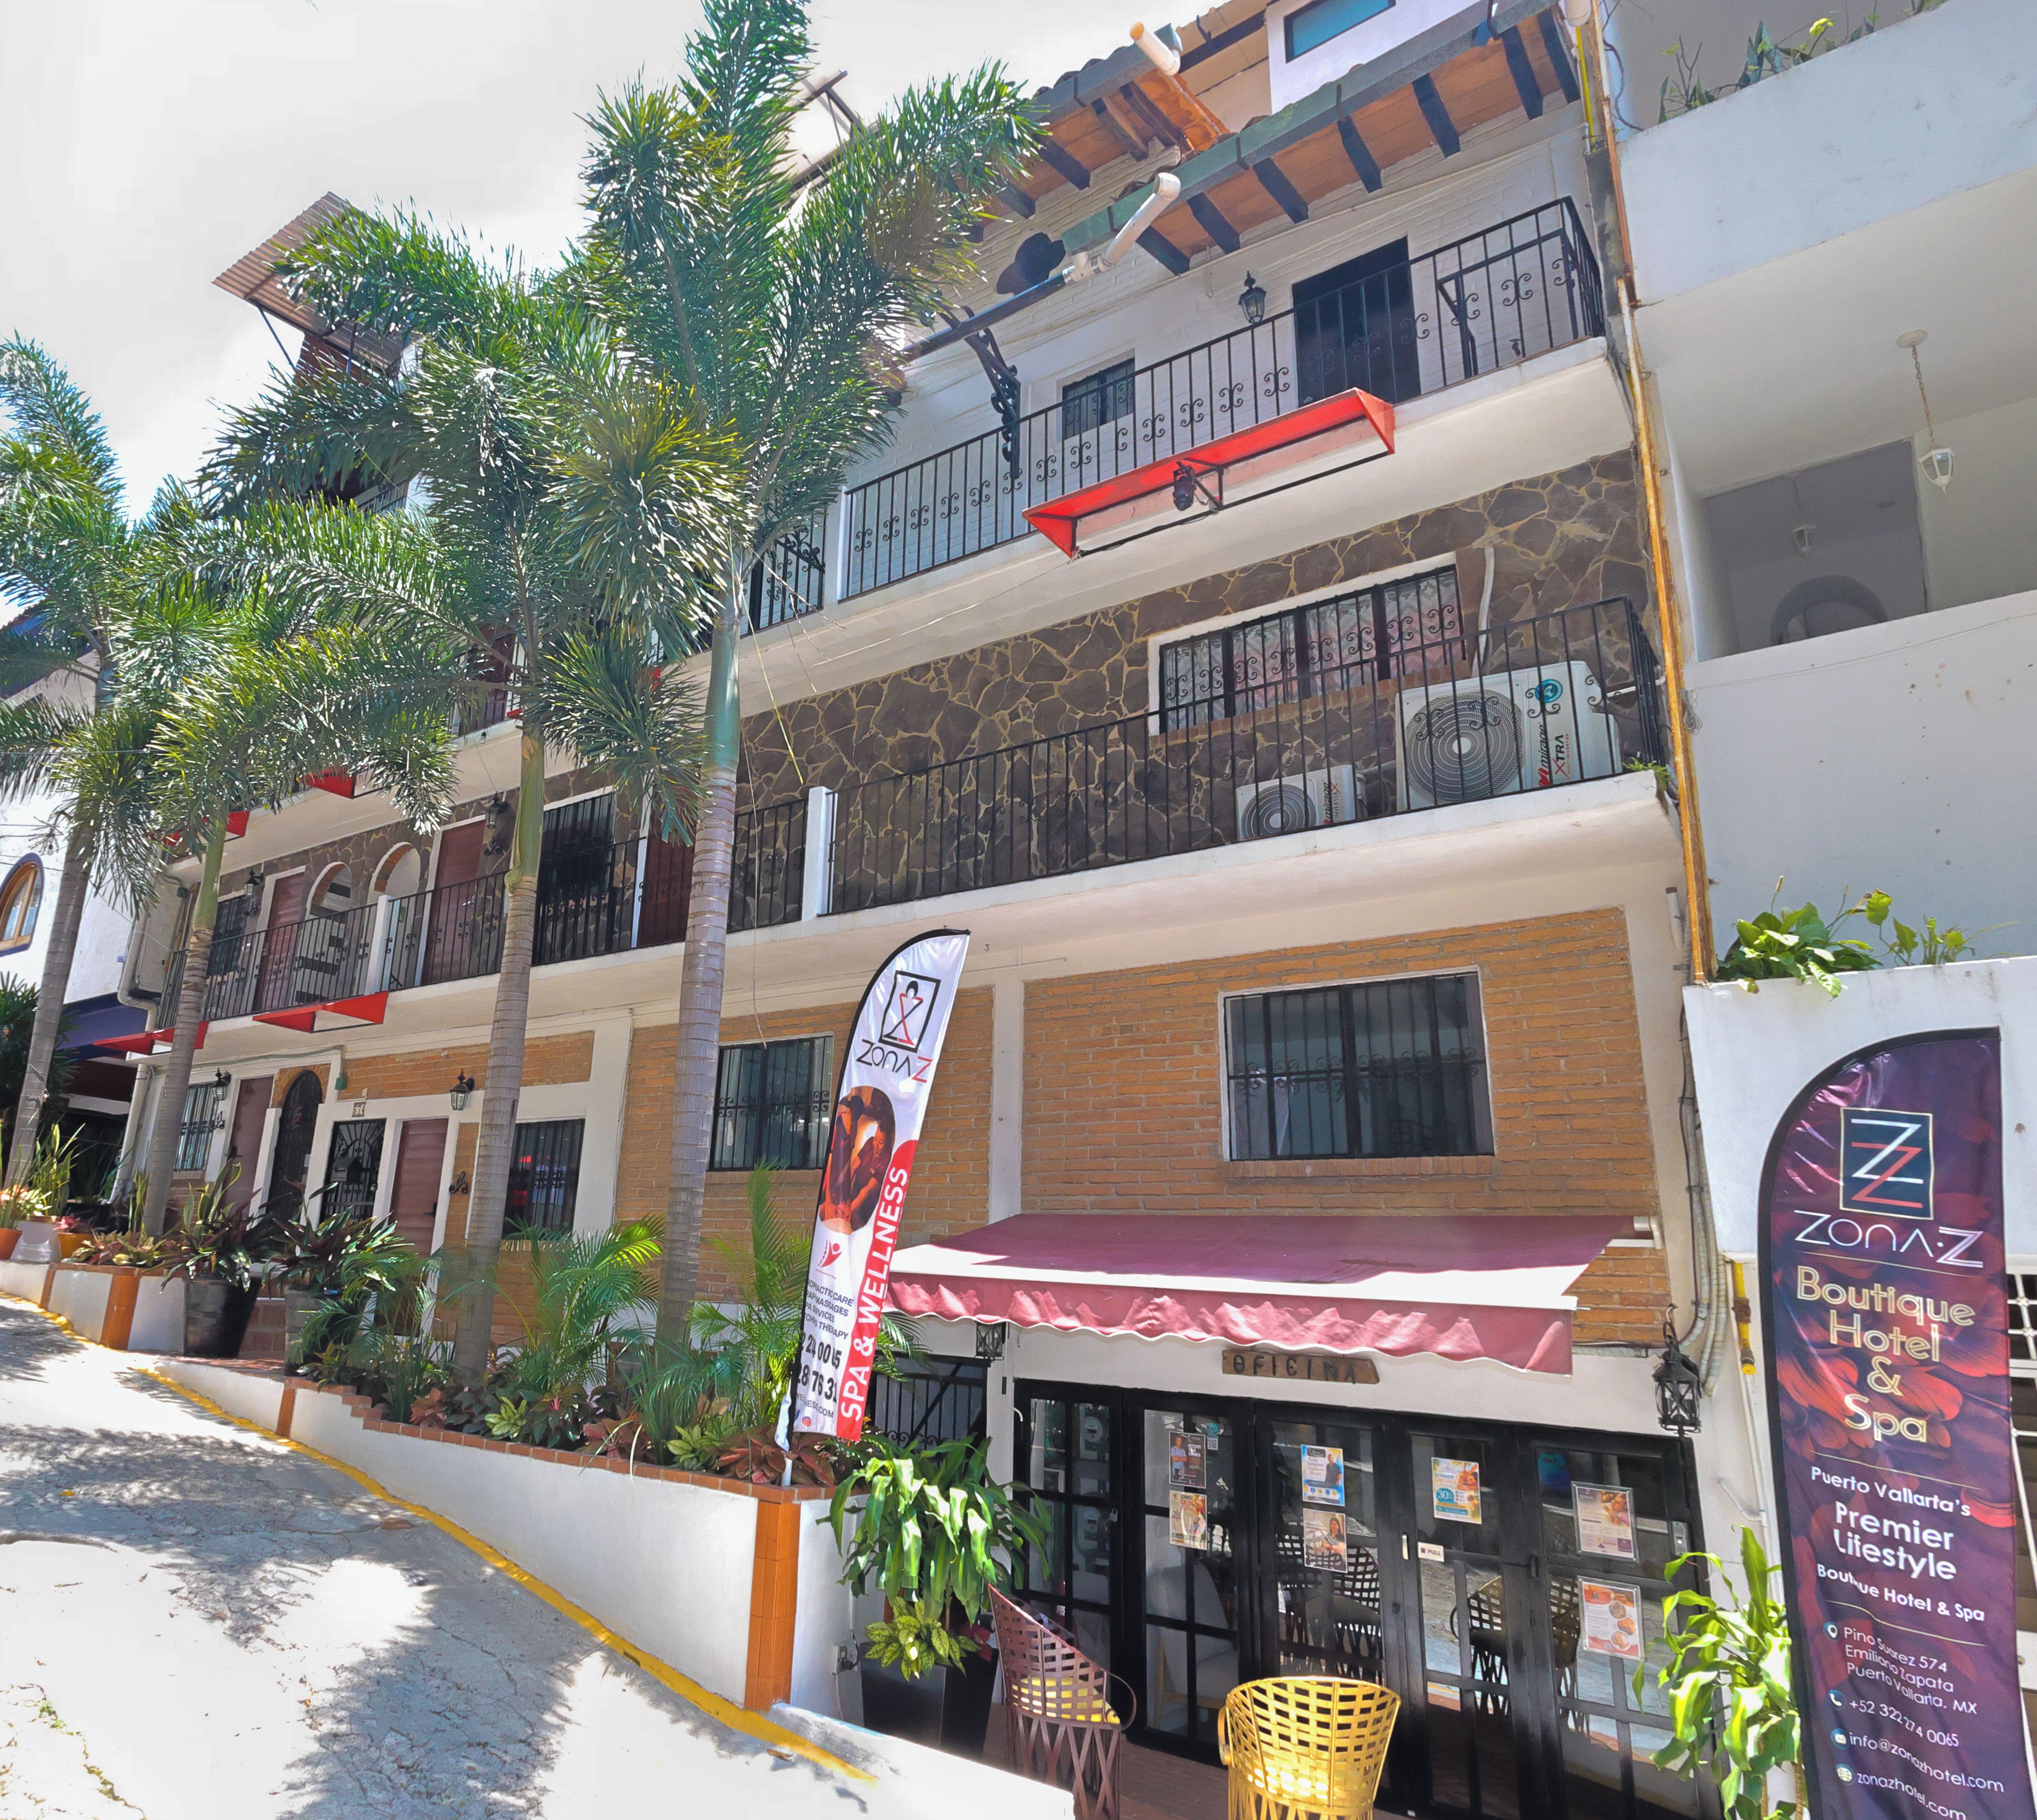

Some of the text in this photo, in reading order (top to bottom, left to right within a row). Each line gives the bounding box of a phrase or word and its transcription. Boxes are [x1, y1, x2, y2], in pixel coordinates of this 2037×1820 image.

[841, 1166, 908, 1422] SPA & WELLNESS
[1797, 1265, 1977, 1326] Boutique
[1830, 1309, 1940, 1362] Hotel
[1867, 1355, 1904, 1396] &
[1844, 1393, 1927, 1443] Spa
[1810, 1466, 1870, 1493] Puerto
[1835, 1500, 1955, 1551] Premier
[1833, 1528, 1957, 1580] Lifestyle
[1884, 1587, 1932, 1612] Hotel
[1937, 1601, 1951, 1616] &
[1955, 1603, 1985, 1622] Spa
[1843, 1626, 1876, 1645] Pino
[1919, 1656, 1948, 1673] 574
[1845, 1644, 1954, 1693] Emiliano Zapata
[1847, 1662, 1892, 1686] Puerto
[1952, 1699, 1978, 1715] MX
[1849, 1699, 1876, 1714] +52
[1926, 1729, 1960, 1747] 0065
[1849, 1731, 2005, 1793] info@zonazhotel.com
[1856, 1772, 1966, 1820] zonazhotel.com
